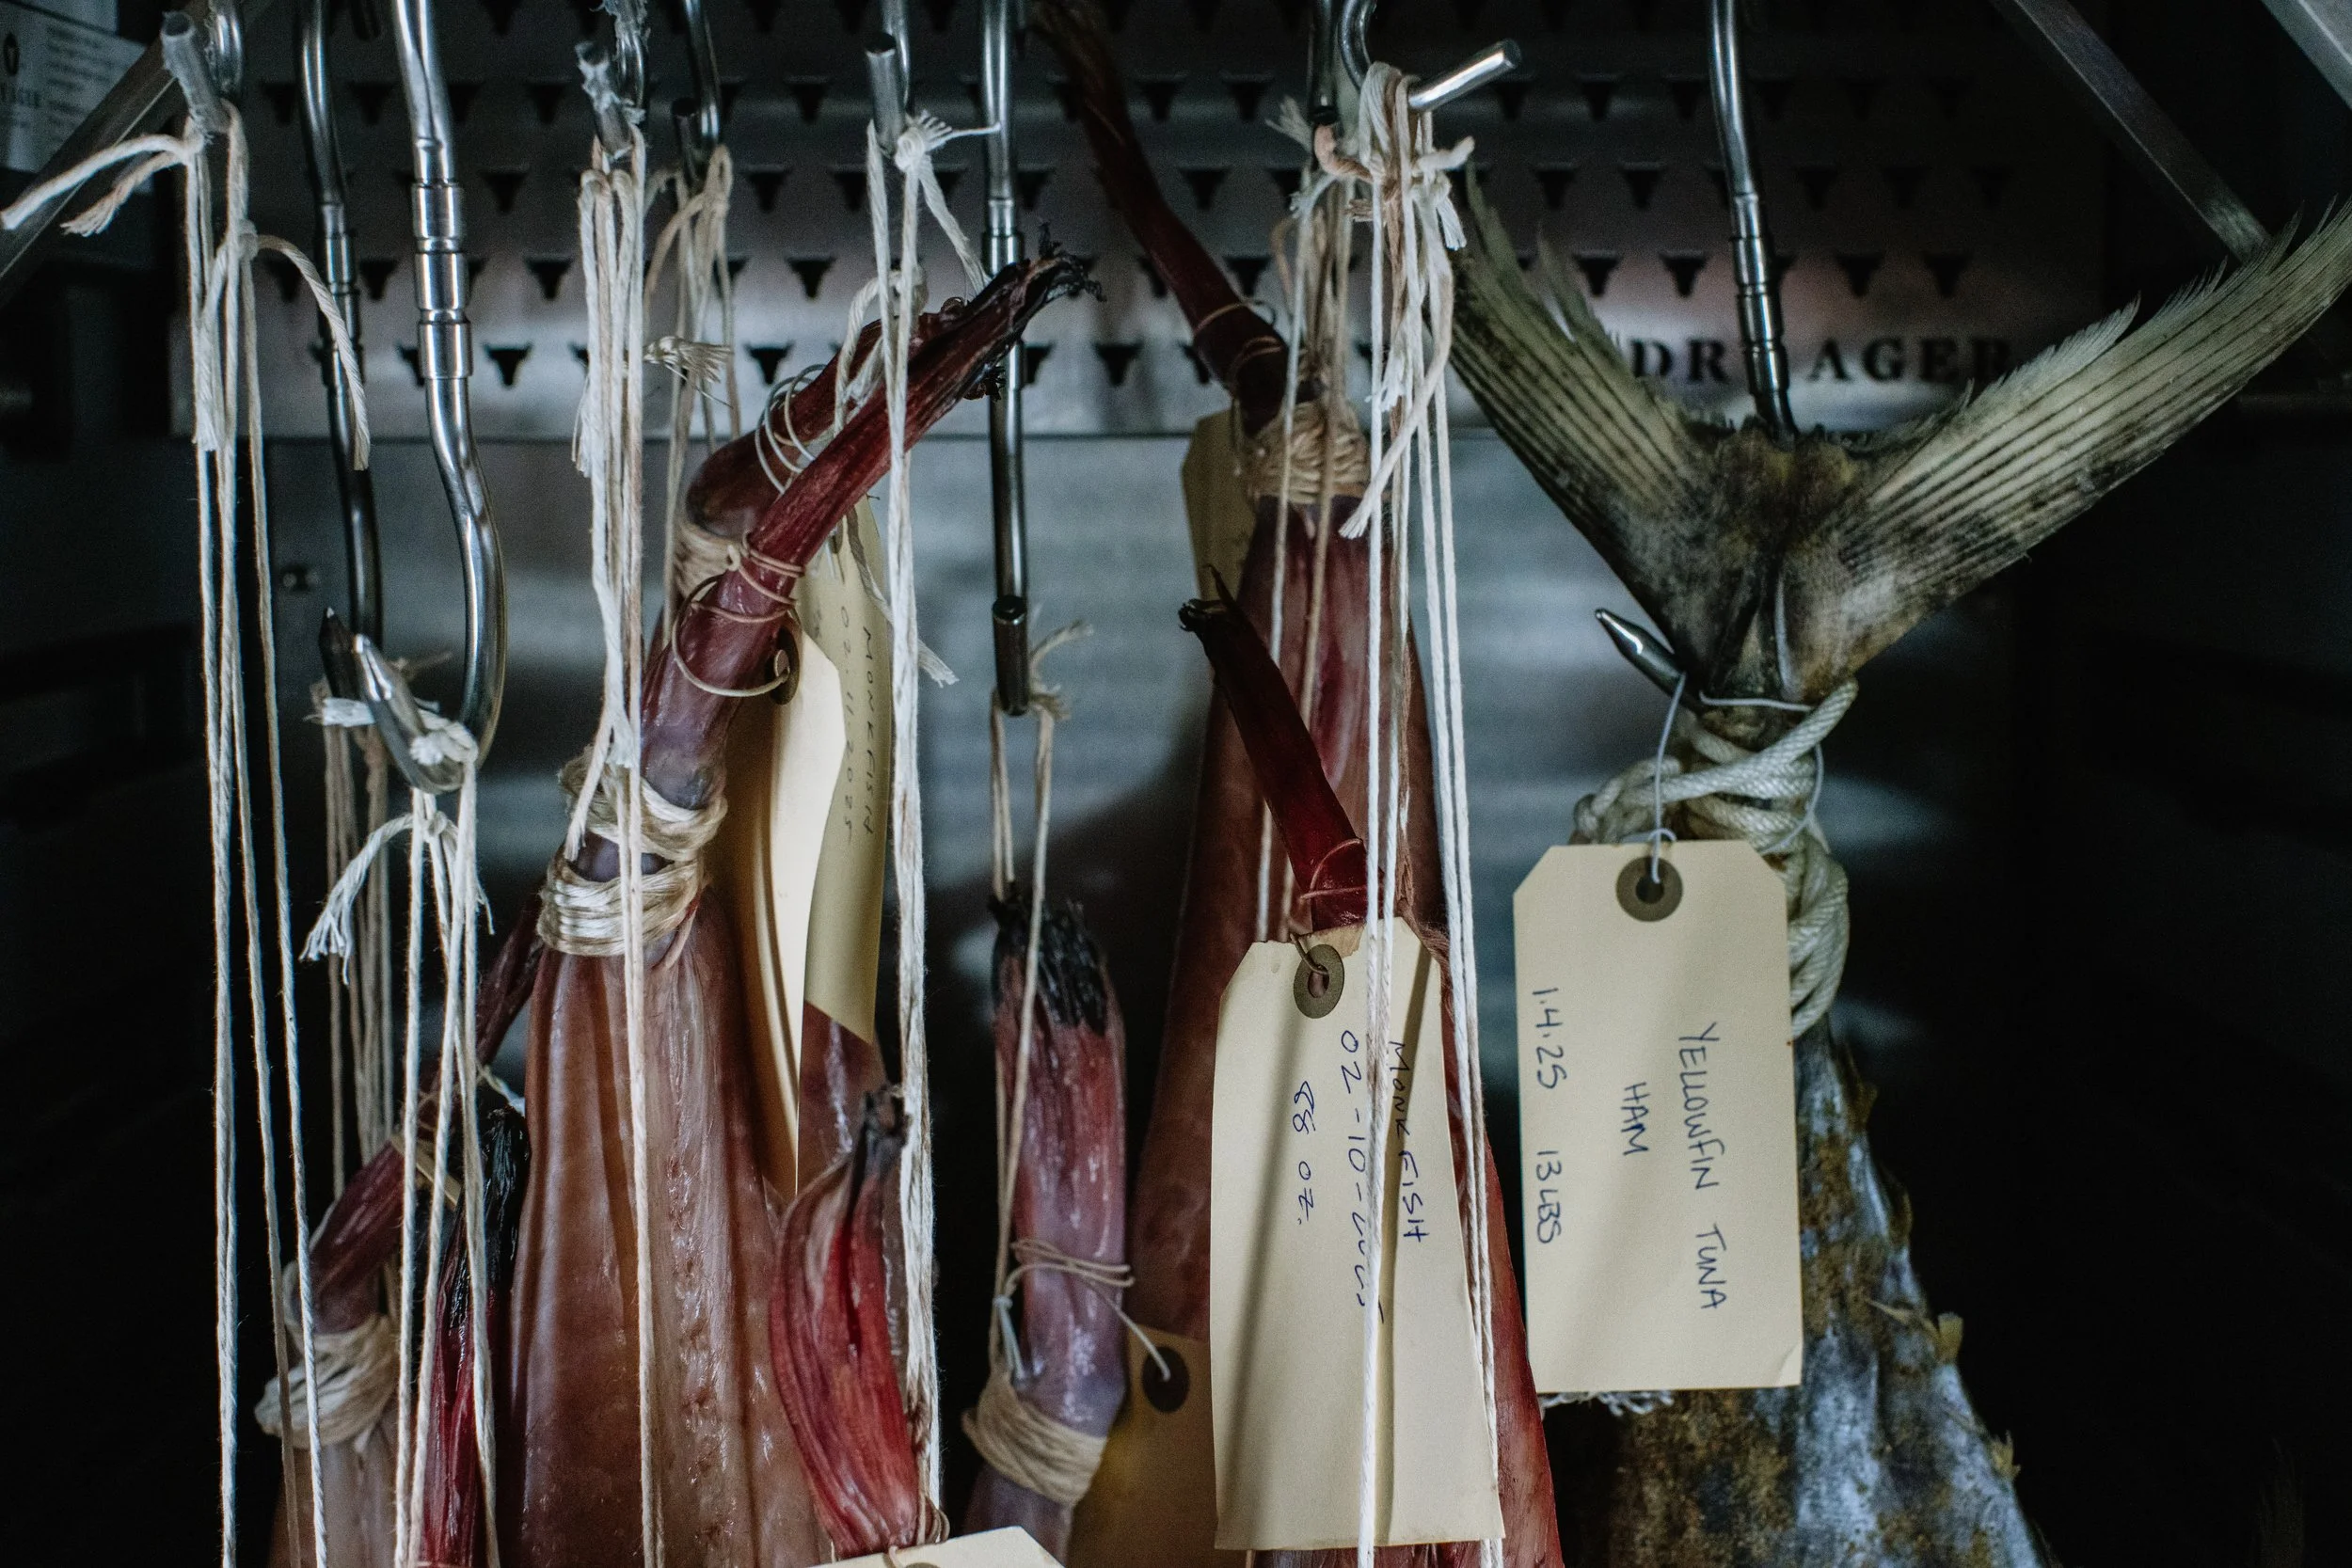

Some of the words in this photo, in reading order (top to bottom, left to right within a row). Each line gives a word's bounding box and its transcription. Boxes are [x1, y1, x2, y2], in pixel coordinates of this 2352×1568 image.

[1630, 338, 1773, 382] DR
[1808, 337, 2014, 384] AGER
[1532, 988, 1567, 1090] 1.4.25
[1293, 1081, 1316, 1133] 88
[1620, 1082, 1651, 1156] HAM
[1677, 1022, 1725, 1190] YELLOWFIN
[1695, 1223, 1728, 1310] TUNA
